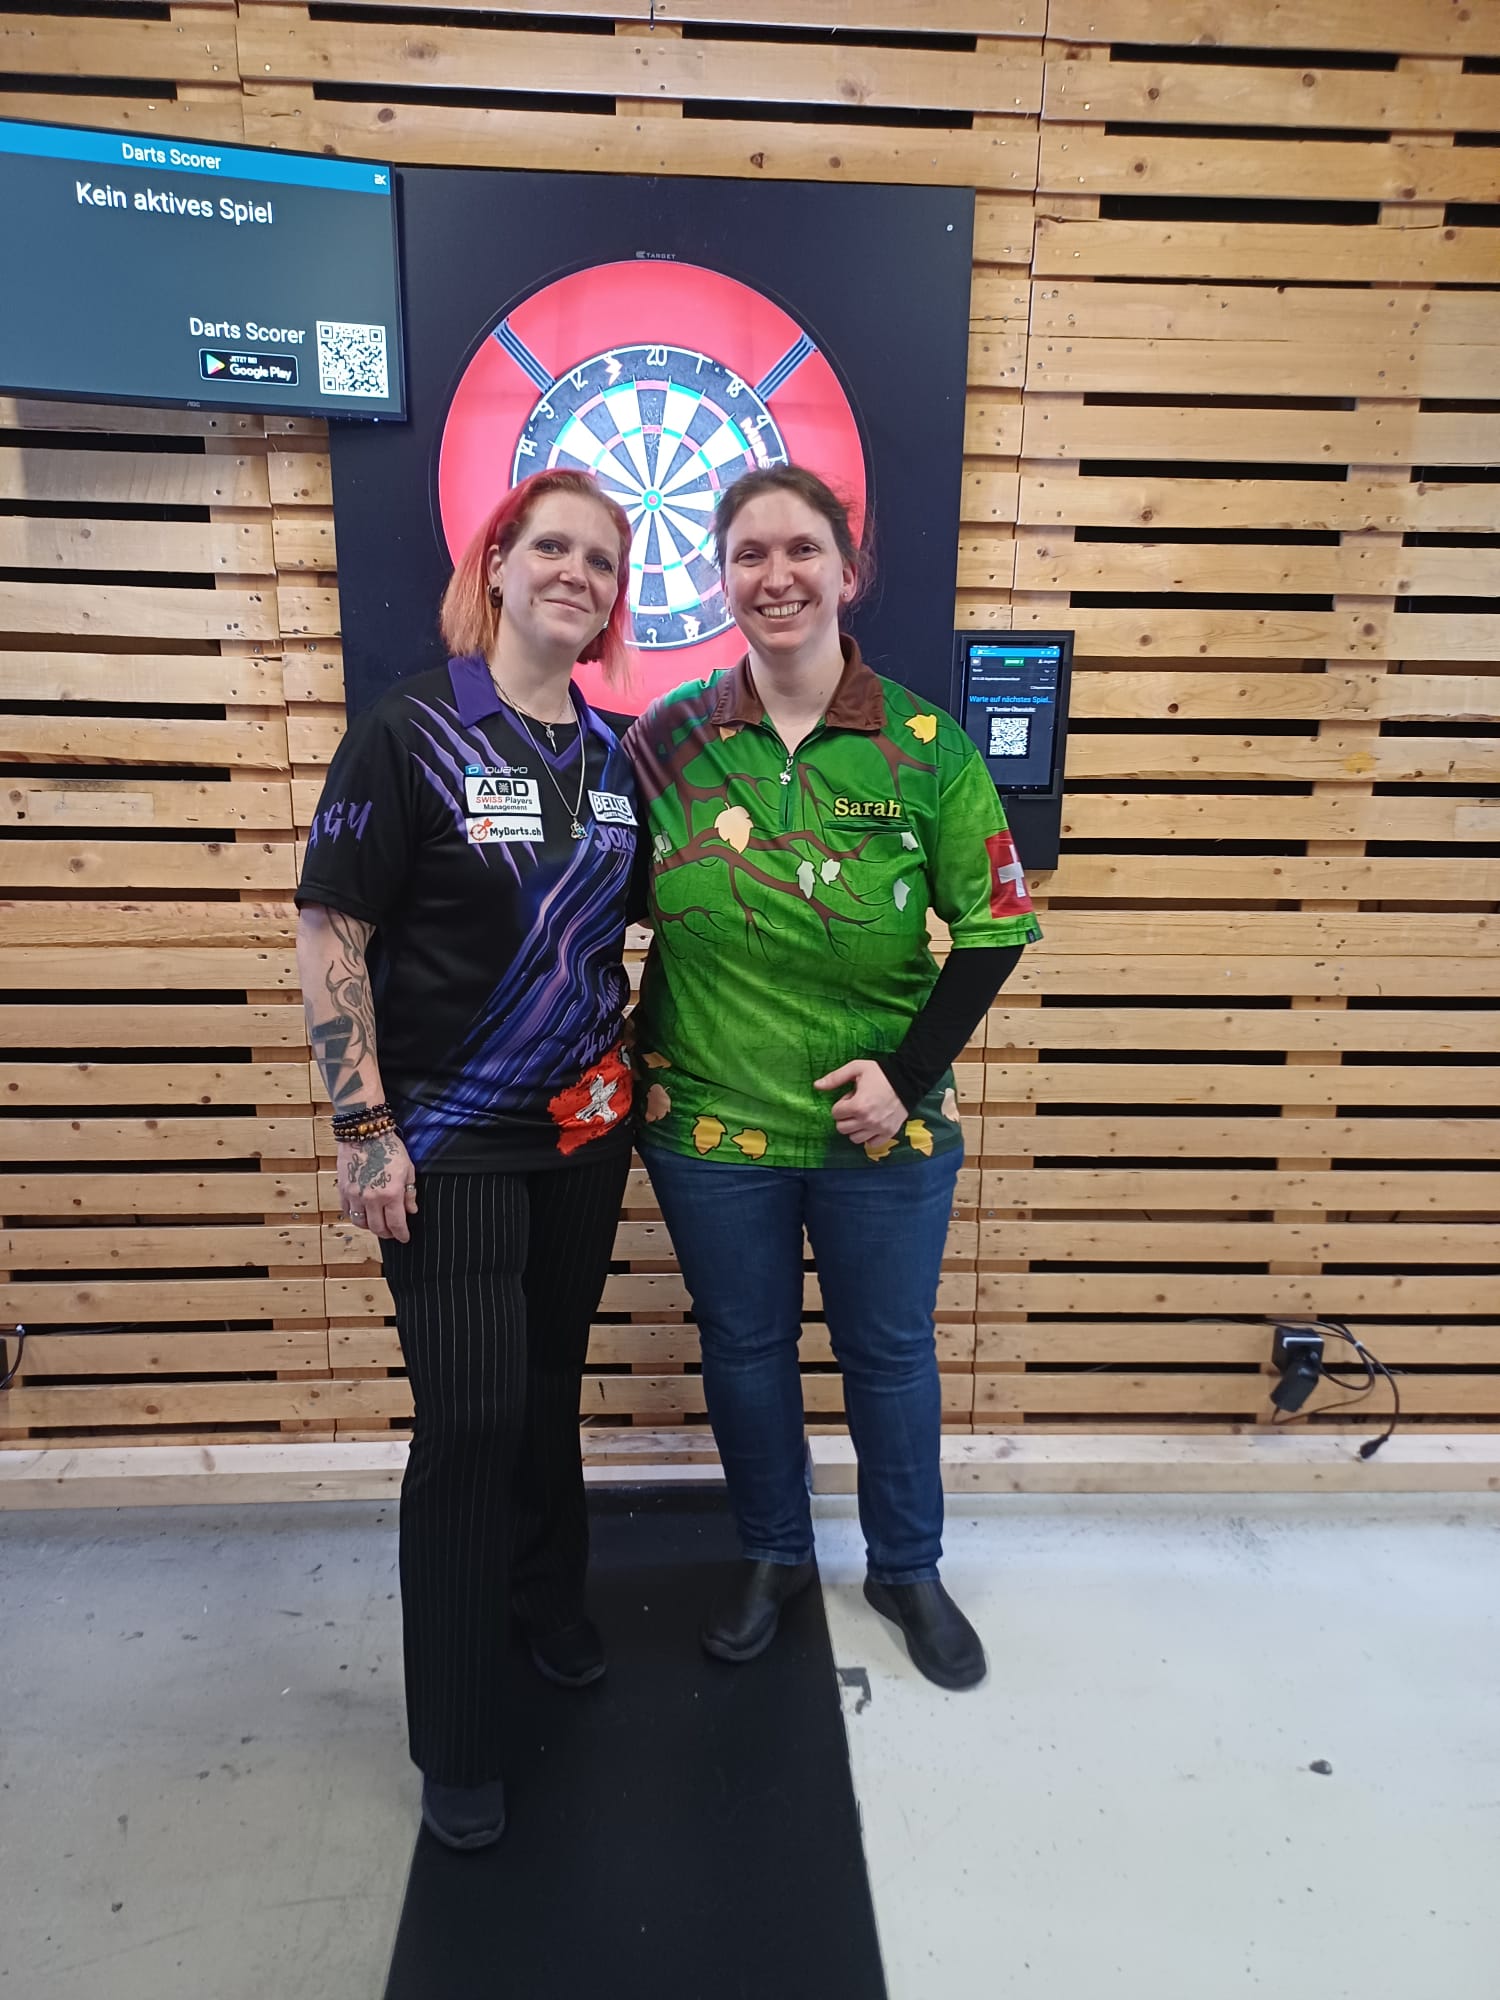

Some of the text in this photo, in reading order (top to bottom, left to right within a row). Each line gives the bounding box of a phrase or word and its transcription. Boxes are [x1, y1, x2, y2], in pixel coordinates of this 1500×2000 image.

[121, 142, 222, 170] Darts Scorer
[75, 181, 273, 226] Kein aktives Spiel
[189, 316, 306, 344] Darts Scorer
[646, 346, 668, 367] 20
[229, 363, 292, 382] Google Play
[969, 695, 989, 703] Warte
[475, 796, 533, 805] SWISS Players
[483, 803, 528, 811] Management
[834, 797, 902, 818] Sarah
[489, 826, 542, 839] MyDarts.ch
